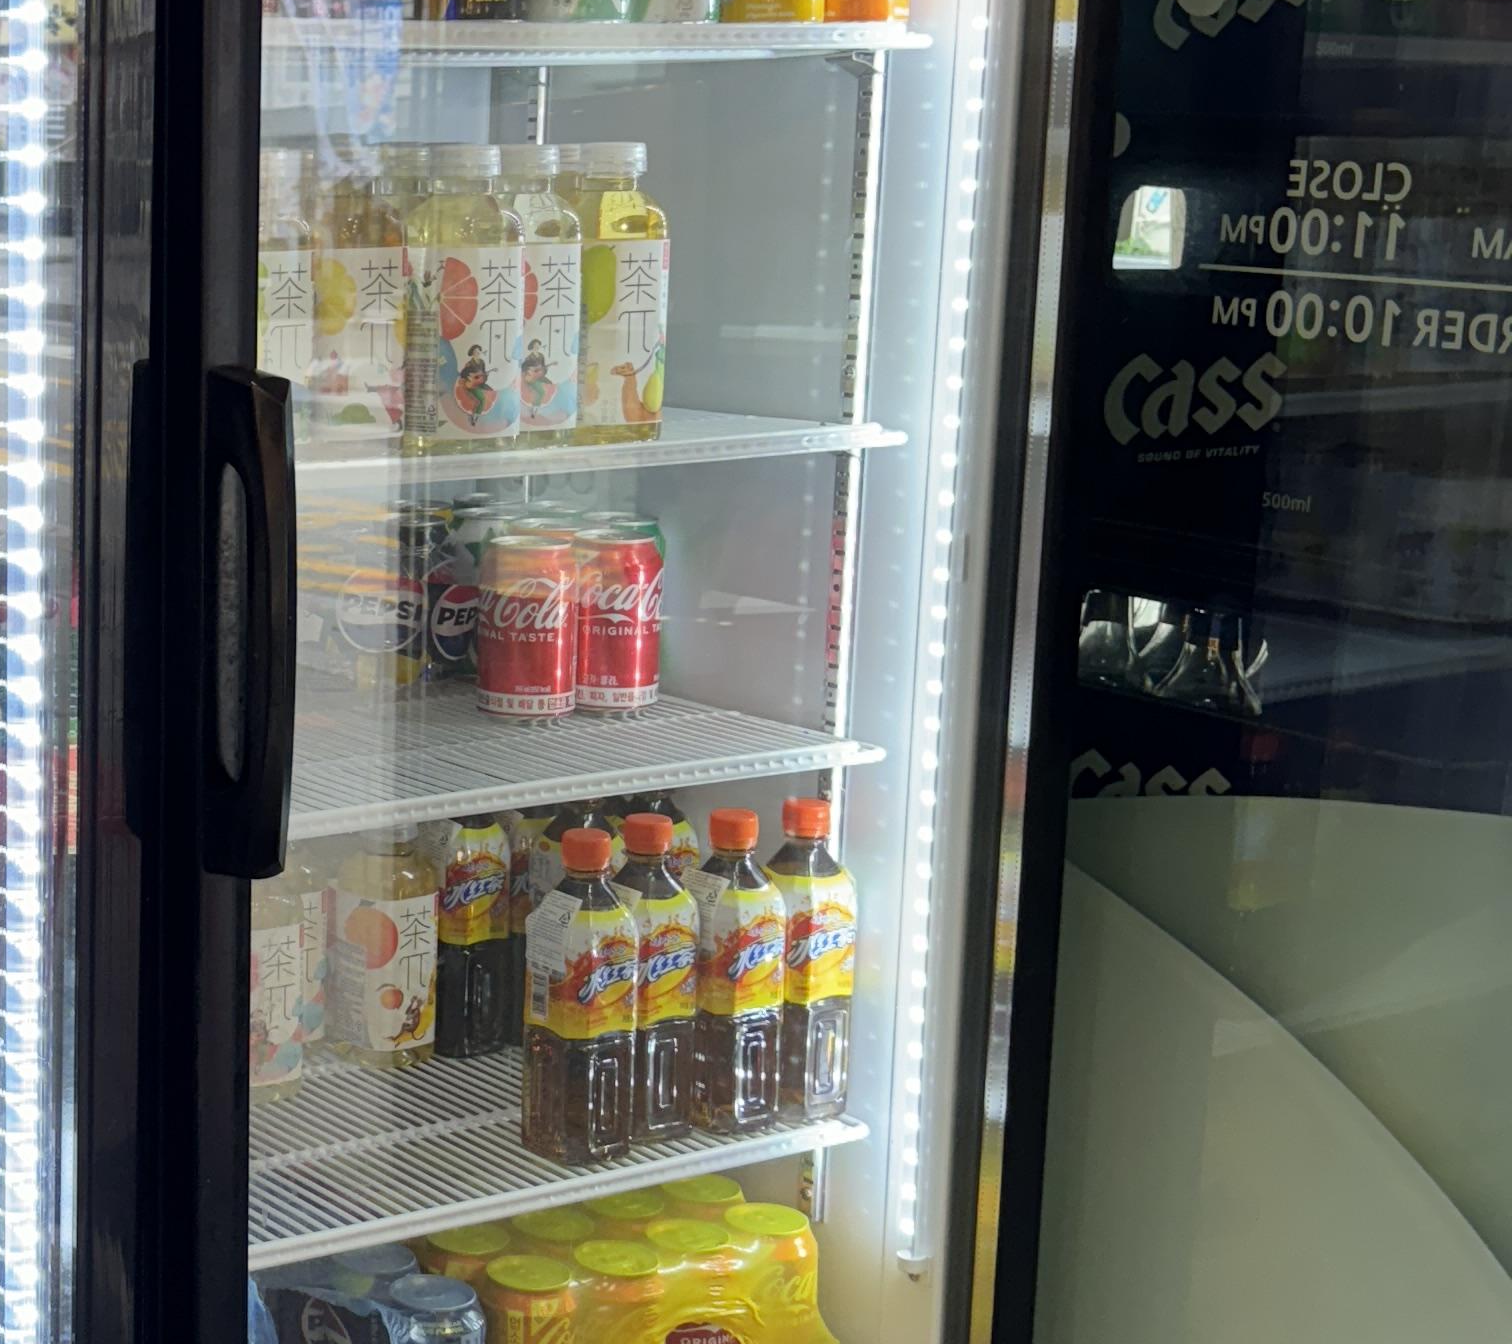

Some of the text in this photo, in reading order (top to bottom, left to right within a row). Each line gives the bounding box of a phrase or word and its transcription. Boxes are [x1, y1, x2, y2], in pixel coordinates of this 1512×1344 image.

[1103, 352, 1288, 445] Cass
[1206, 444, 1261, 459] VITALITY
[1262, 491, 1312, 513] 500ml
[510, 631, 555, 643] TASTE
[582, 623, 649, 637] ORIGINAL
